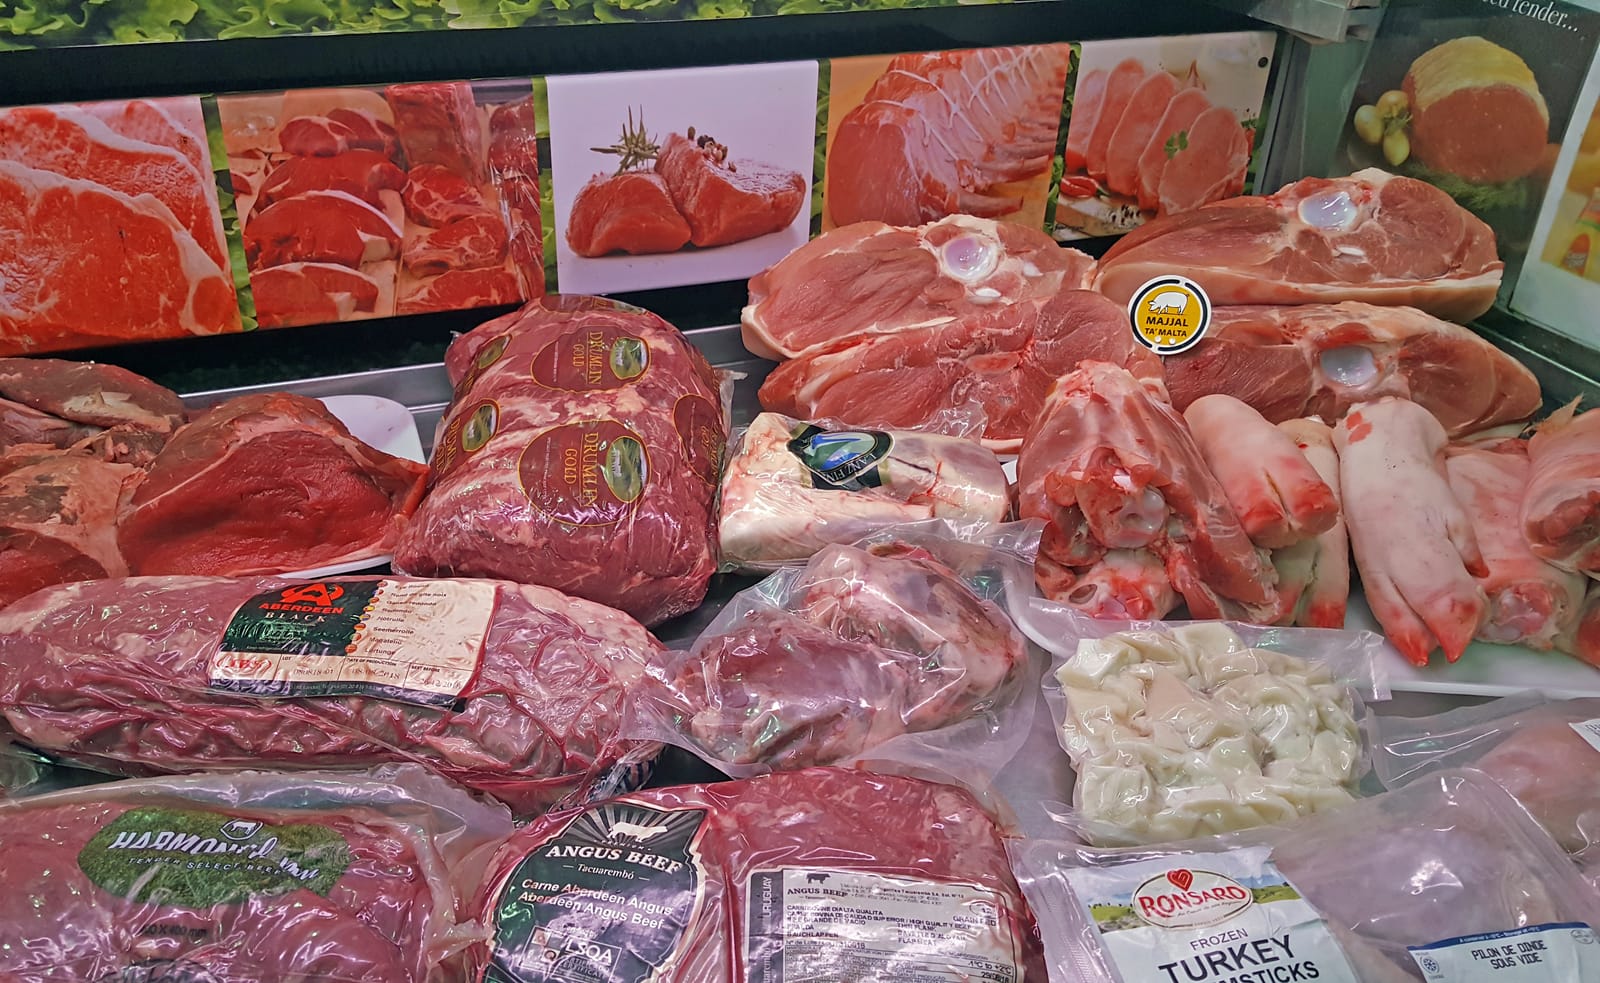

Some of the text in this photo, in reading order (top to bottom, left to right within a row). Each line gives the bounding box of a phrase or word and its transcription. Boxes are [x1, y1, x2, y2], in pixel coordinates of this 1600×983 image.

[1512, 0, 1579, 32] tender...
[1146, 316, 1188, 327] MAJJAL
[1158, 328, 1187, 337] MALTA
[572, 343, 585, 367] GOLD
[588, 331, 604, 385] DRUMLIN
[563, 447, 578, 485] GOLD
[582, 432, 599, 507] DRUMLIN
[259, 602, 345, 615] ABERDEEN
[265, 612, 328, 623] BLACK
[186, 861, 241, 871] SELECT
[546, 845, 683, 875] ANGUS BEEF
[577, 863, 635, 880] Tacuarembó
[522, 879, 674, 916] Carne Aberdeen Angus
[762, 877, 773, 918] URUGUAY
[787, 887, 848, 897] ANGUS BEEF
[1138, 883, 1248, 920] RONSARD
[518, 891, 665, 930] Aberdeen Angus Beef
[565, 939, 612, 963] LSQA
[1190, 928, 1249, 951] FROZEN
[1471, 940, 1548, 960] PILON DE DINDE
[1158, 934, 1295, 983] TURKEY
[1490, 952, 1543, 970] SOUS VIDE
